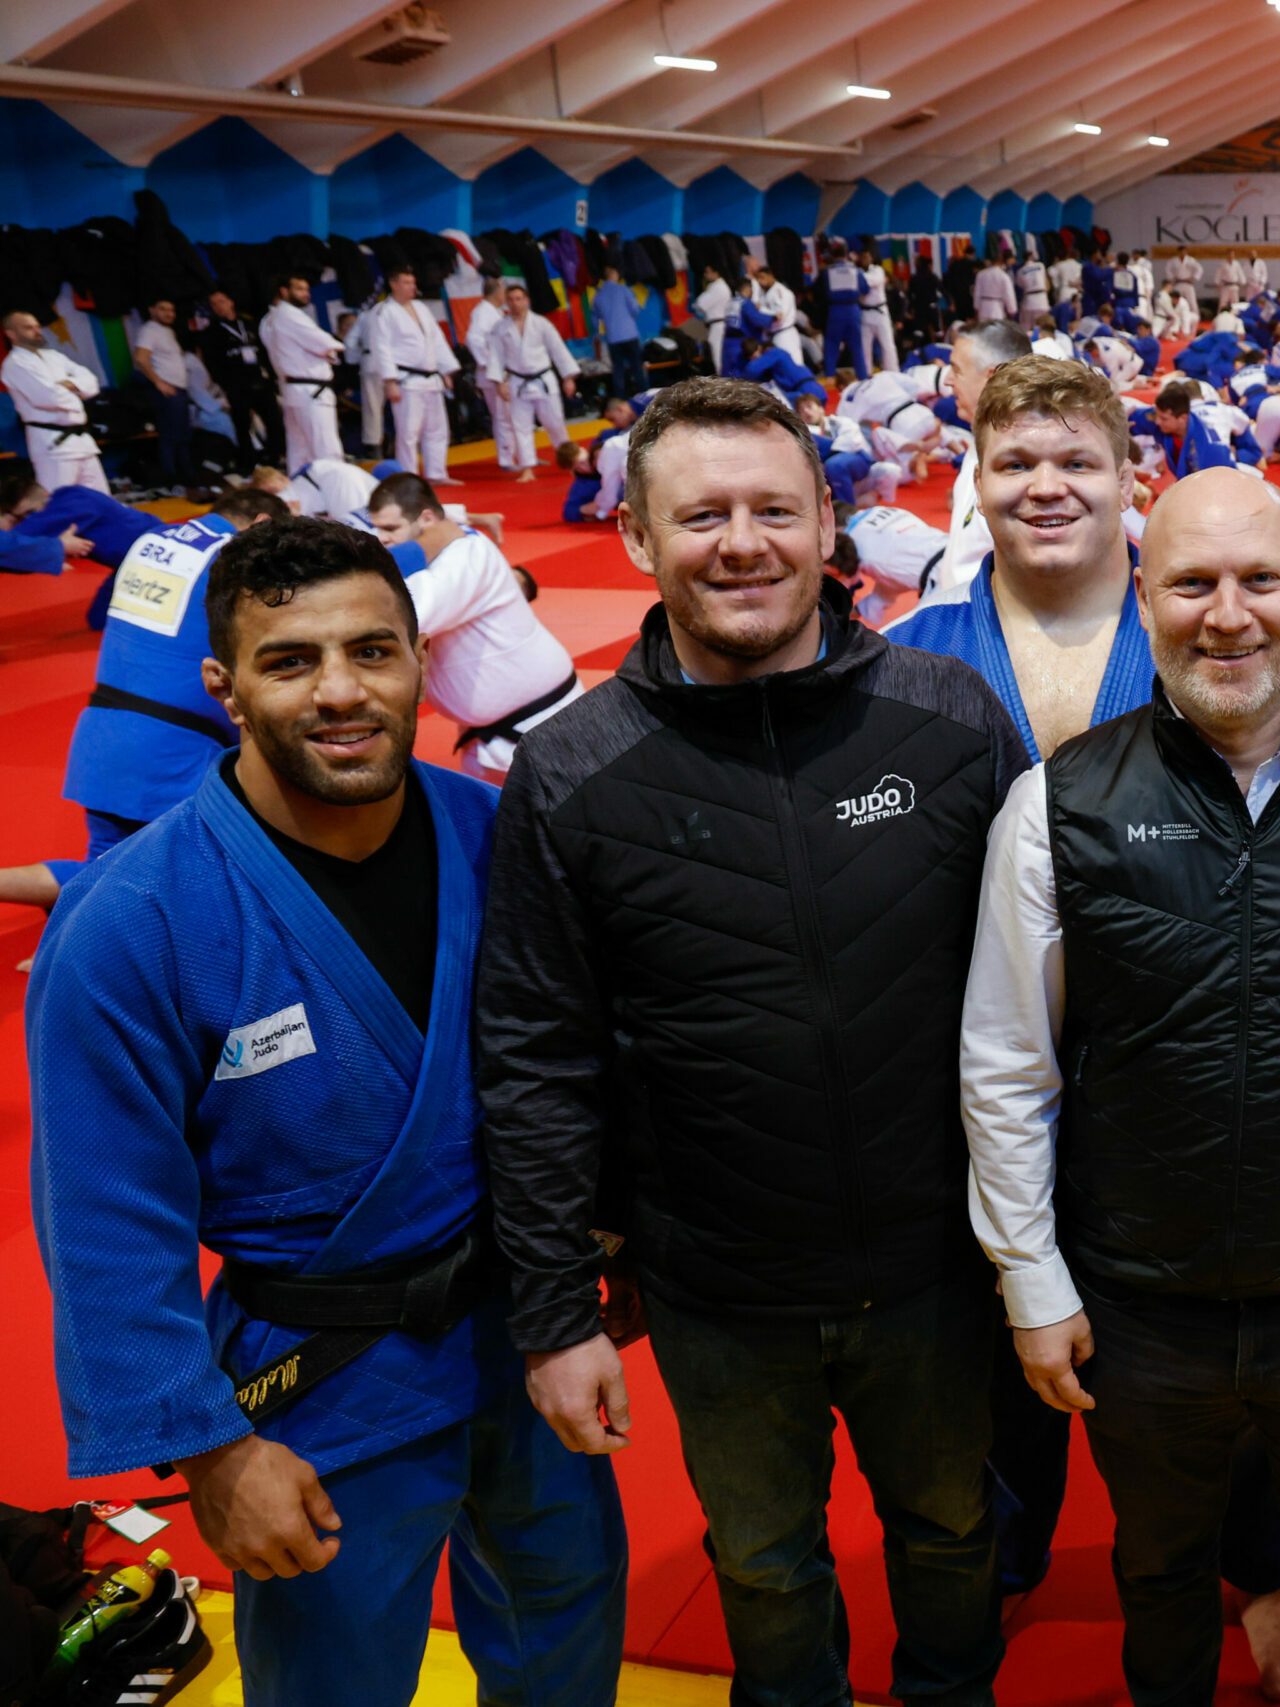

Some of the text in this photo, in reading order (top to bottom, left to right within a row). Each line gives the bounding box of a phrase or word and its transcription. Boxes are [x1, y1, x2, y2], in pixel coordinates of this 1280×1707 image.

[836, 788, 901, 820] JUDO
[850, 806, 904, 828] AUSTRIA
[1127, 823, 1161, 842] M+
[251, 1021, 306, 1050] Azerbaijan
[253, 1043, 279, 1060] Judo
